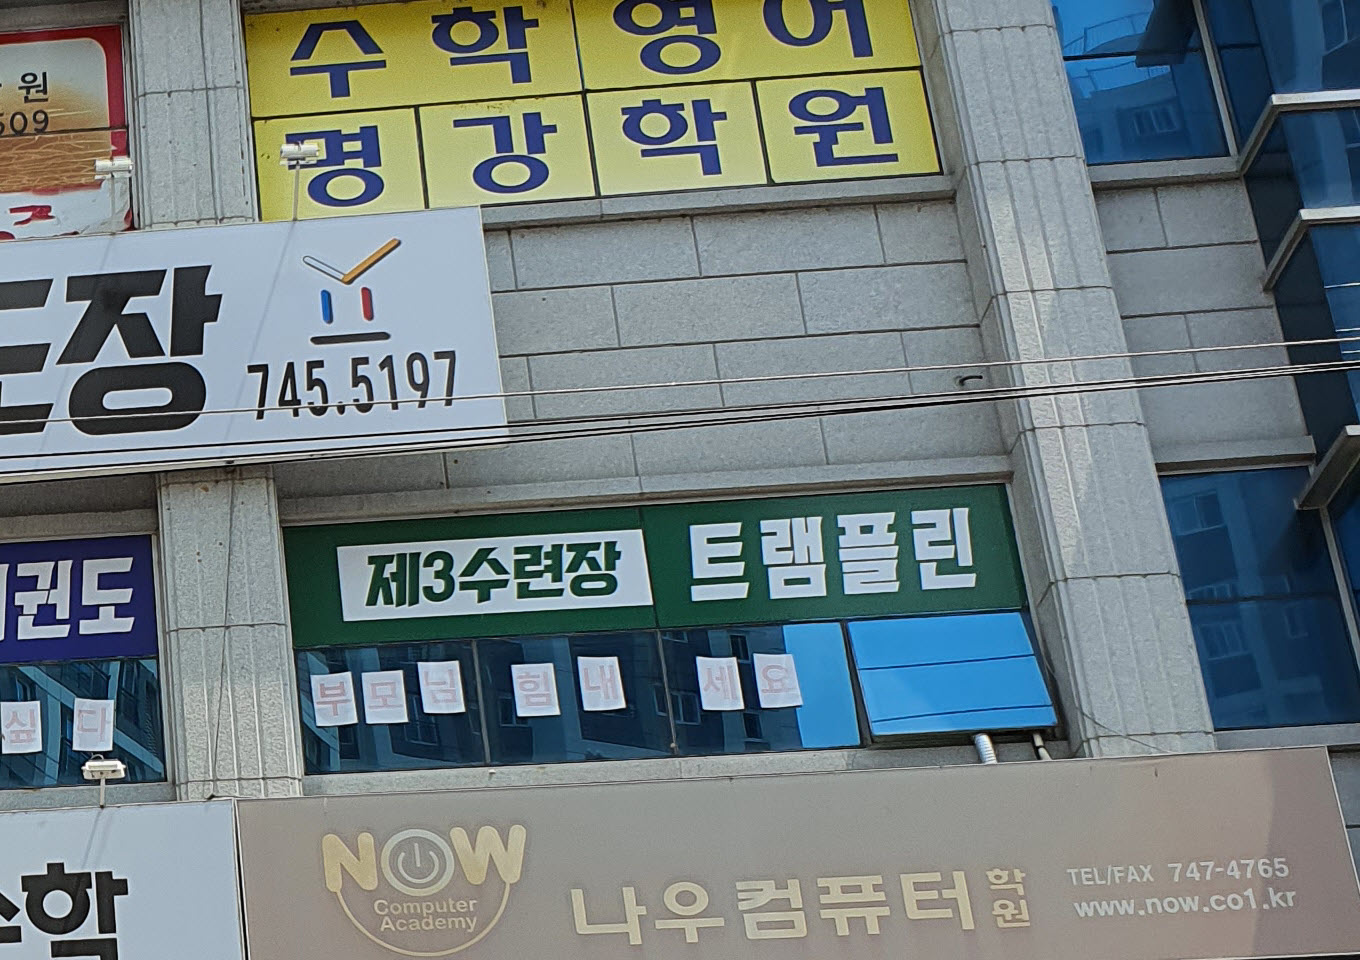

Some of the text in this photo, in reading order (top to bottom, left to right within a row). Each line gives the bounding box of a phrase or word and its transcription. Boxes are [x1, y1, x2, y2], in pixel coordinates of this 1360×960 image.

[289, 5, 540, 98] 수학
[247, 351, 456, 421] 745.5197
[366, 507, 977, 609] 제3수련장 트램플린
[322, 824, 526, 896] NOW
[1067, 857, 1290, 886] TEL/FAX 747-4765
[373, 898, 477, 917] Computer
[380, 914, 478, 933] Academy
[571, 870, 975, 945] 나우컴퓨터
[985, 867, 1031, 929] 학원
